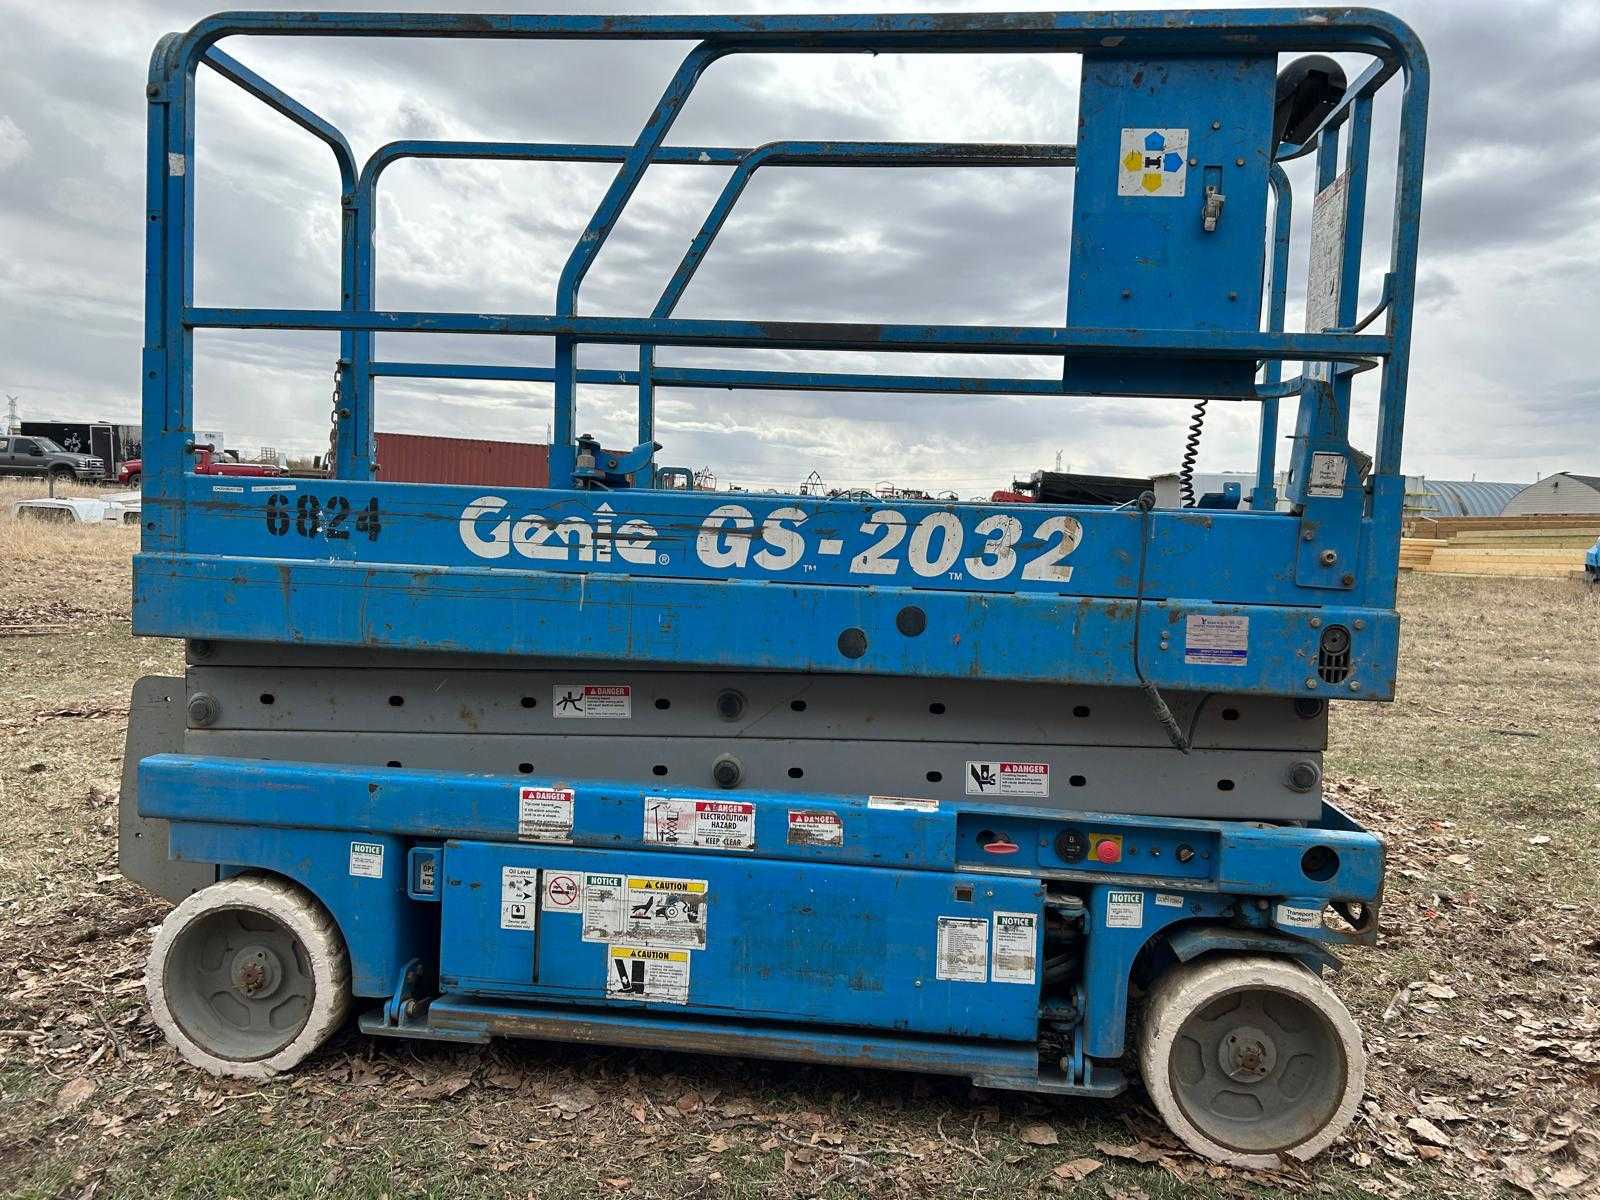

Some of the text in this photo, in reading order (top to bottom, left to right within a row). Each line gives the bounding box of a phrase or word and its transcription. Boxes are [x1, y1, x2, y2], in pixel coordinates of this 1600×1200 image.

[266, 494, 381, 542] 6824
[1012, 764, 1044, 774] DANGER
[536, 792, 566, 800] DANGER
[712, 804, 744, 812] DANGER
[700, 813, 748, 822] ELECTROCUTION
[804, 816, 834, 824] DANGER
[711, 821, 737, 830] HAZARD
[722, 838, 742, 846] CLEAR
[354, 844, 380, 854] NOTICE
[590, 876, 618, 886] NOTICE
[654, 882, 688, 891] CAUTION
[1112, 894, 1140, 902] NOTICE
[1002, 918, 1029, 926] NOTICE
[637, 950, 670, 960] CAUTION
